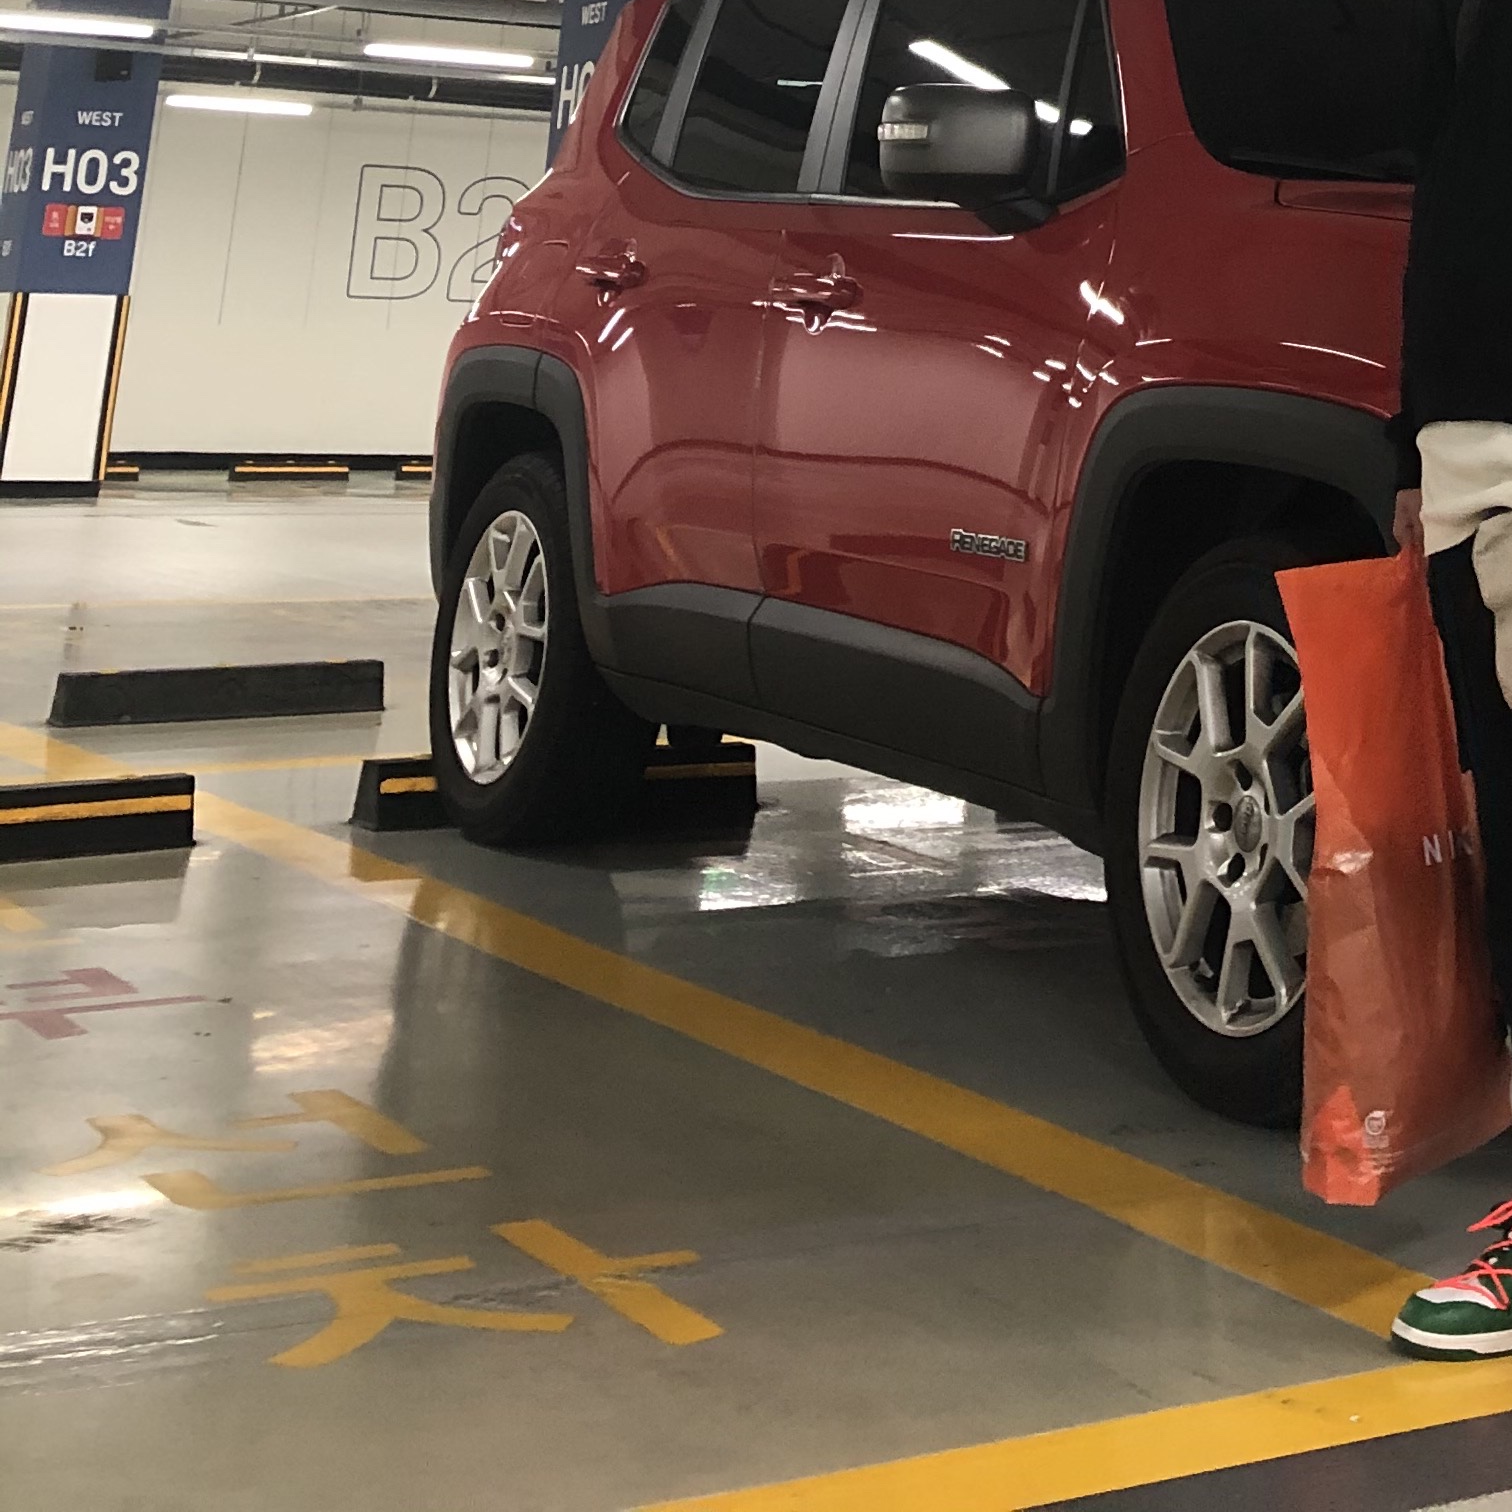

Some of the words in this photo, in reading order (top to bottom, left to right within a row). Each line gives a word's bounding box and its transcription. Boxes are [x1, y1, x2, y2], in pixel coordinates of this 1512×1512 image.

[581, 1, 608, 26] WEST
[77, 111, 124, 126] WEST
[41, 147, 140, 196] H03
[63, 240, 96, 258] B2f
[950, 528, 1027, 563] RENEGADE
